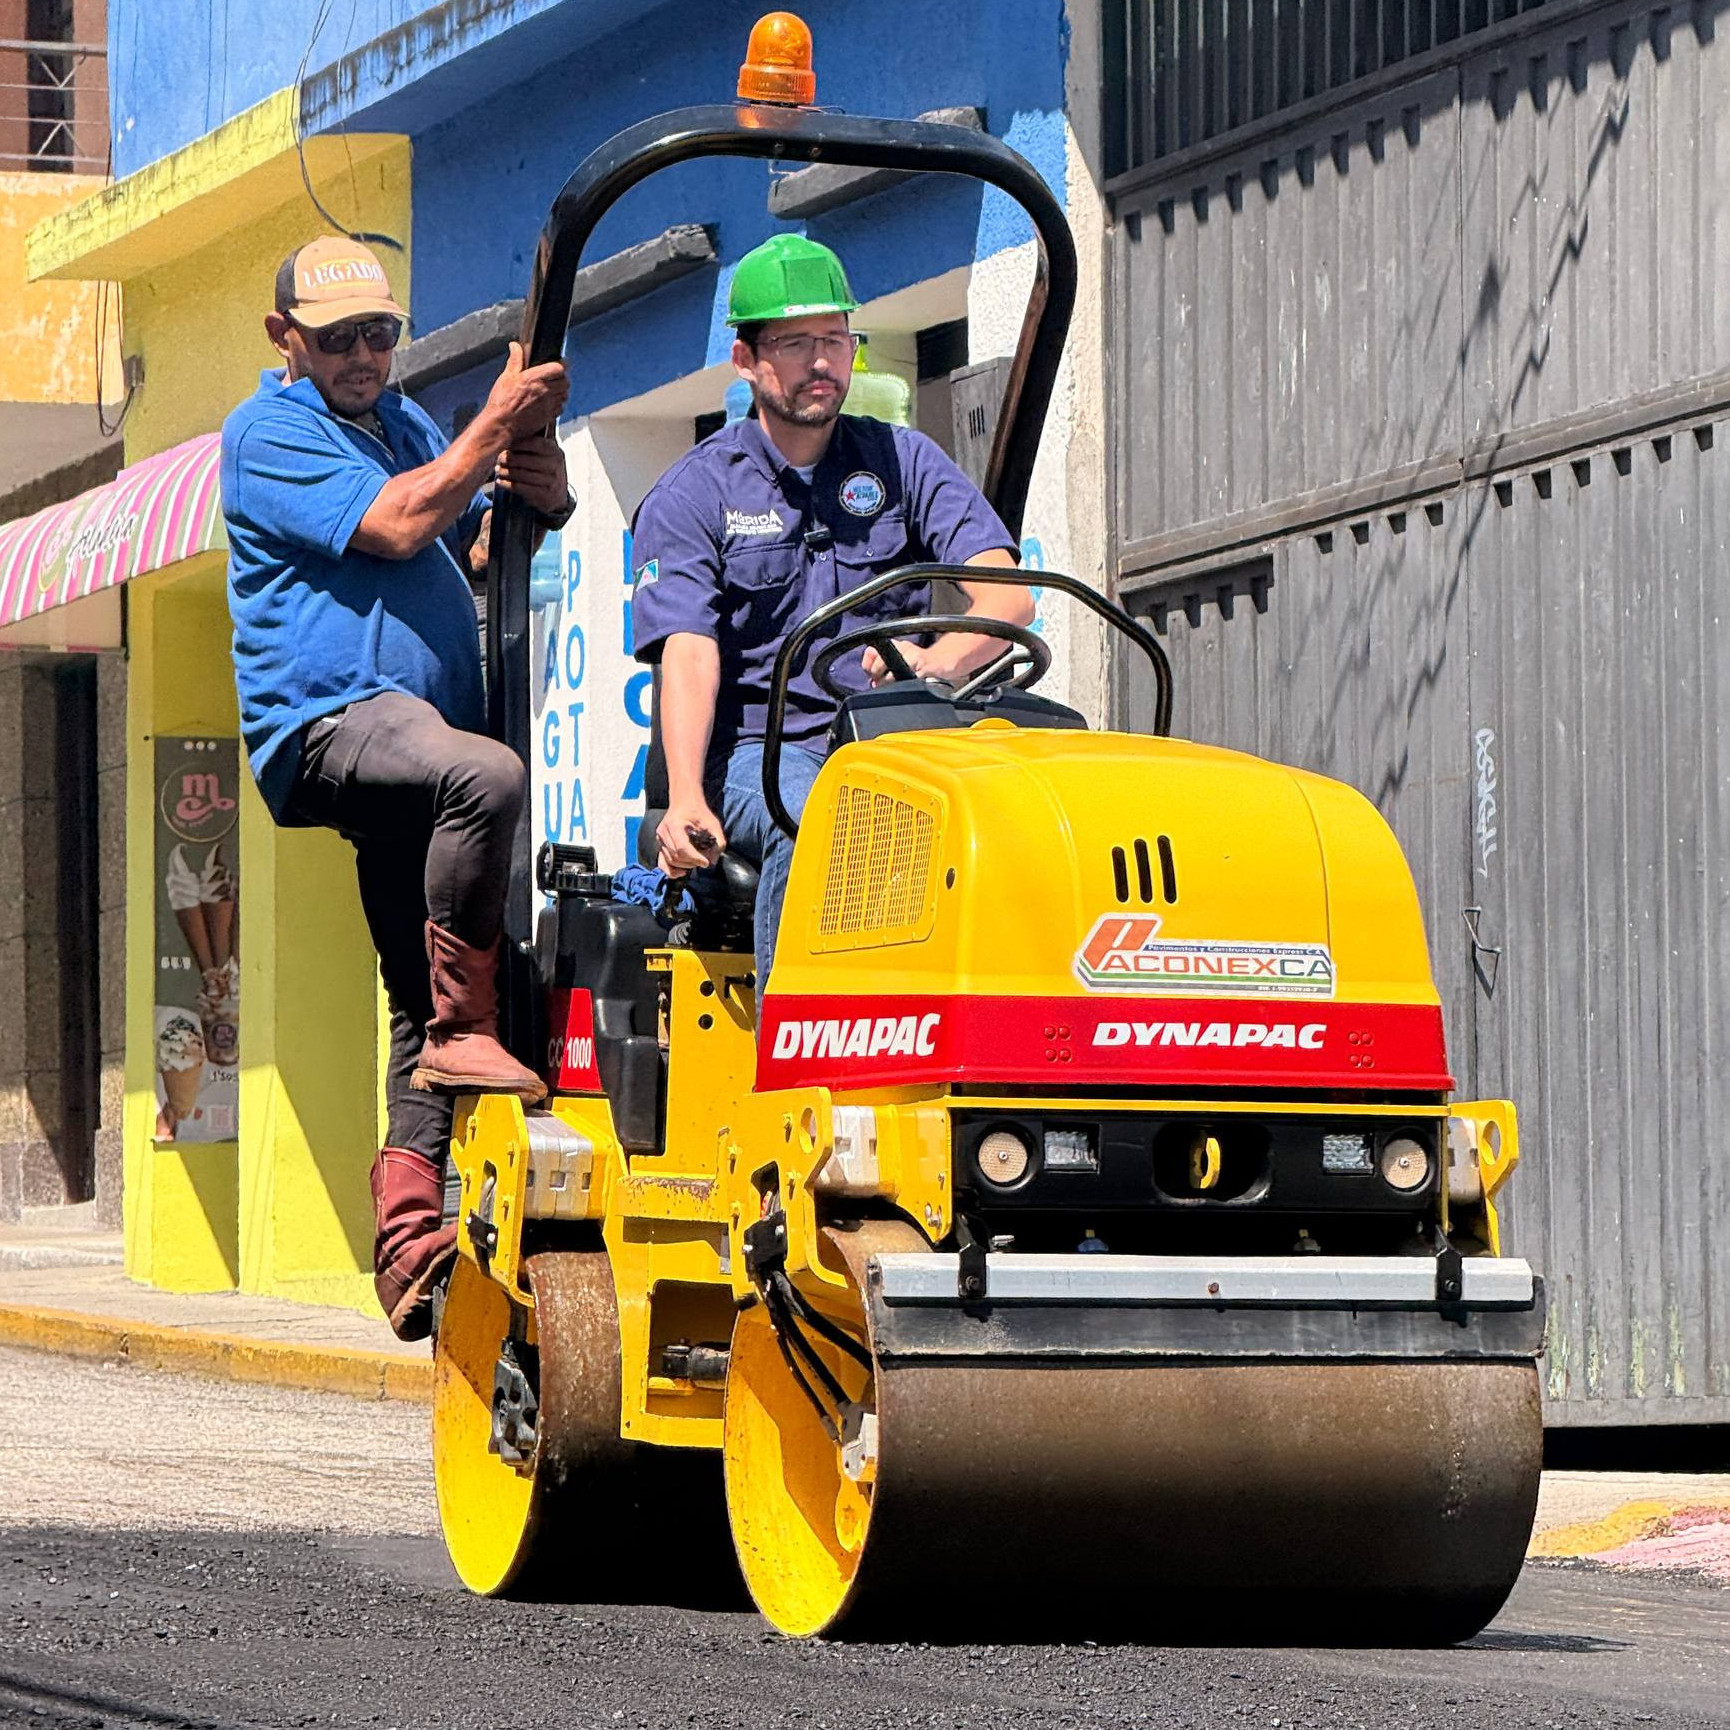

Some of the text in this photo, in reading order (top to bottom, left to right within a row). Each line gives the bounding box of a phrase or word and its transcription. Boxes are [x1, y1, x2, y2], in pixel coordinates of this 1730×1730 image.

[303, 261, 383, 288] LEGADO
[772, 1013, 940, 1059] DYNAPAC
[1092, 1022, 1327, 1049] DYNAPAC
[566, 1036, 592, 1069] 1000
